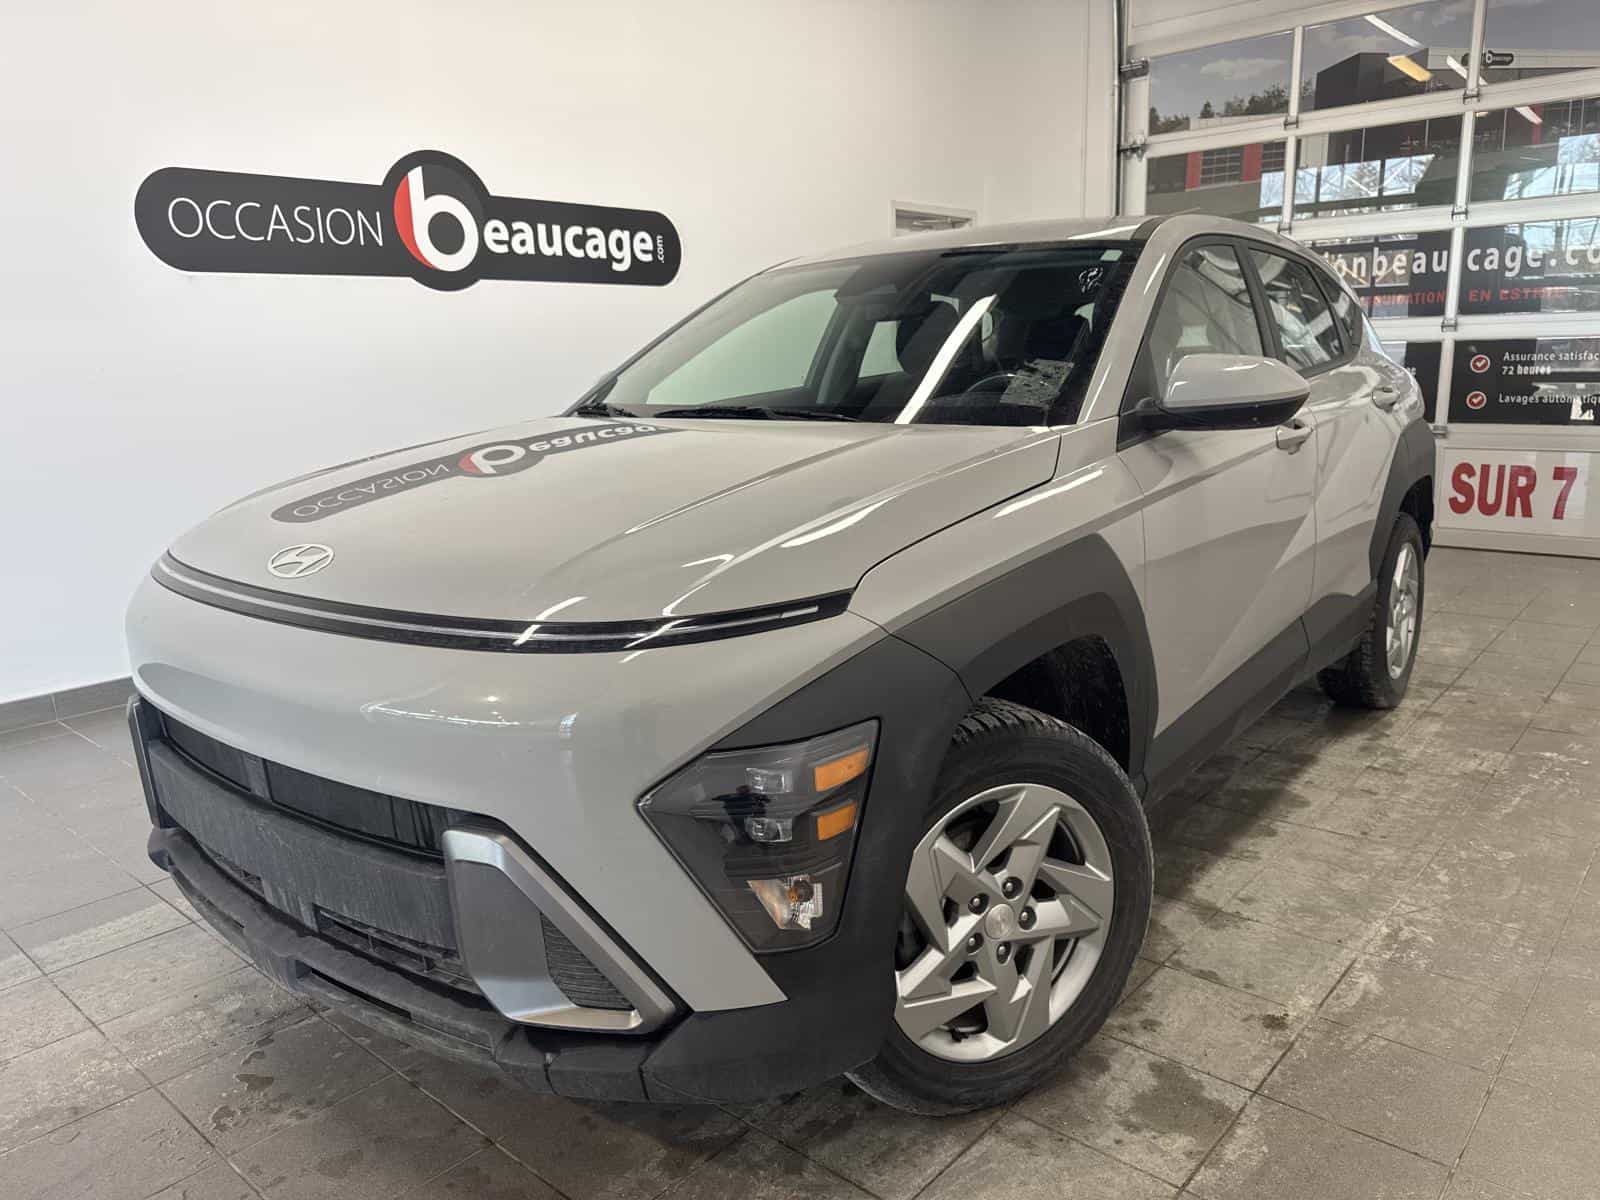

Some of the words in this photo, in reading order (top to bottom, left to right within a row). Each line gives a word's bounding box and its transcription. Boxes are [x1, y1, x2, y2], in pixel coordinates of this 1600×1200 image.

[168, 196, 383, 247] OCCASION
[1468, 288, 1492, 303] EN
[1503, 351, 1556, 361] Assurance
[1502, 365, 1514, 375] 72
[1498, 393, 1540, 405] Lavages
[1448, 462, 1537, 518] SUR
[1552, 466, 1579, 520] 7
